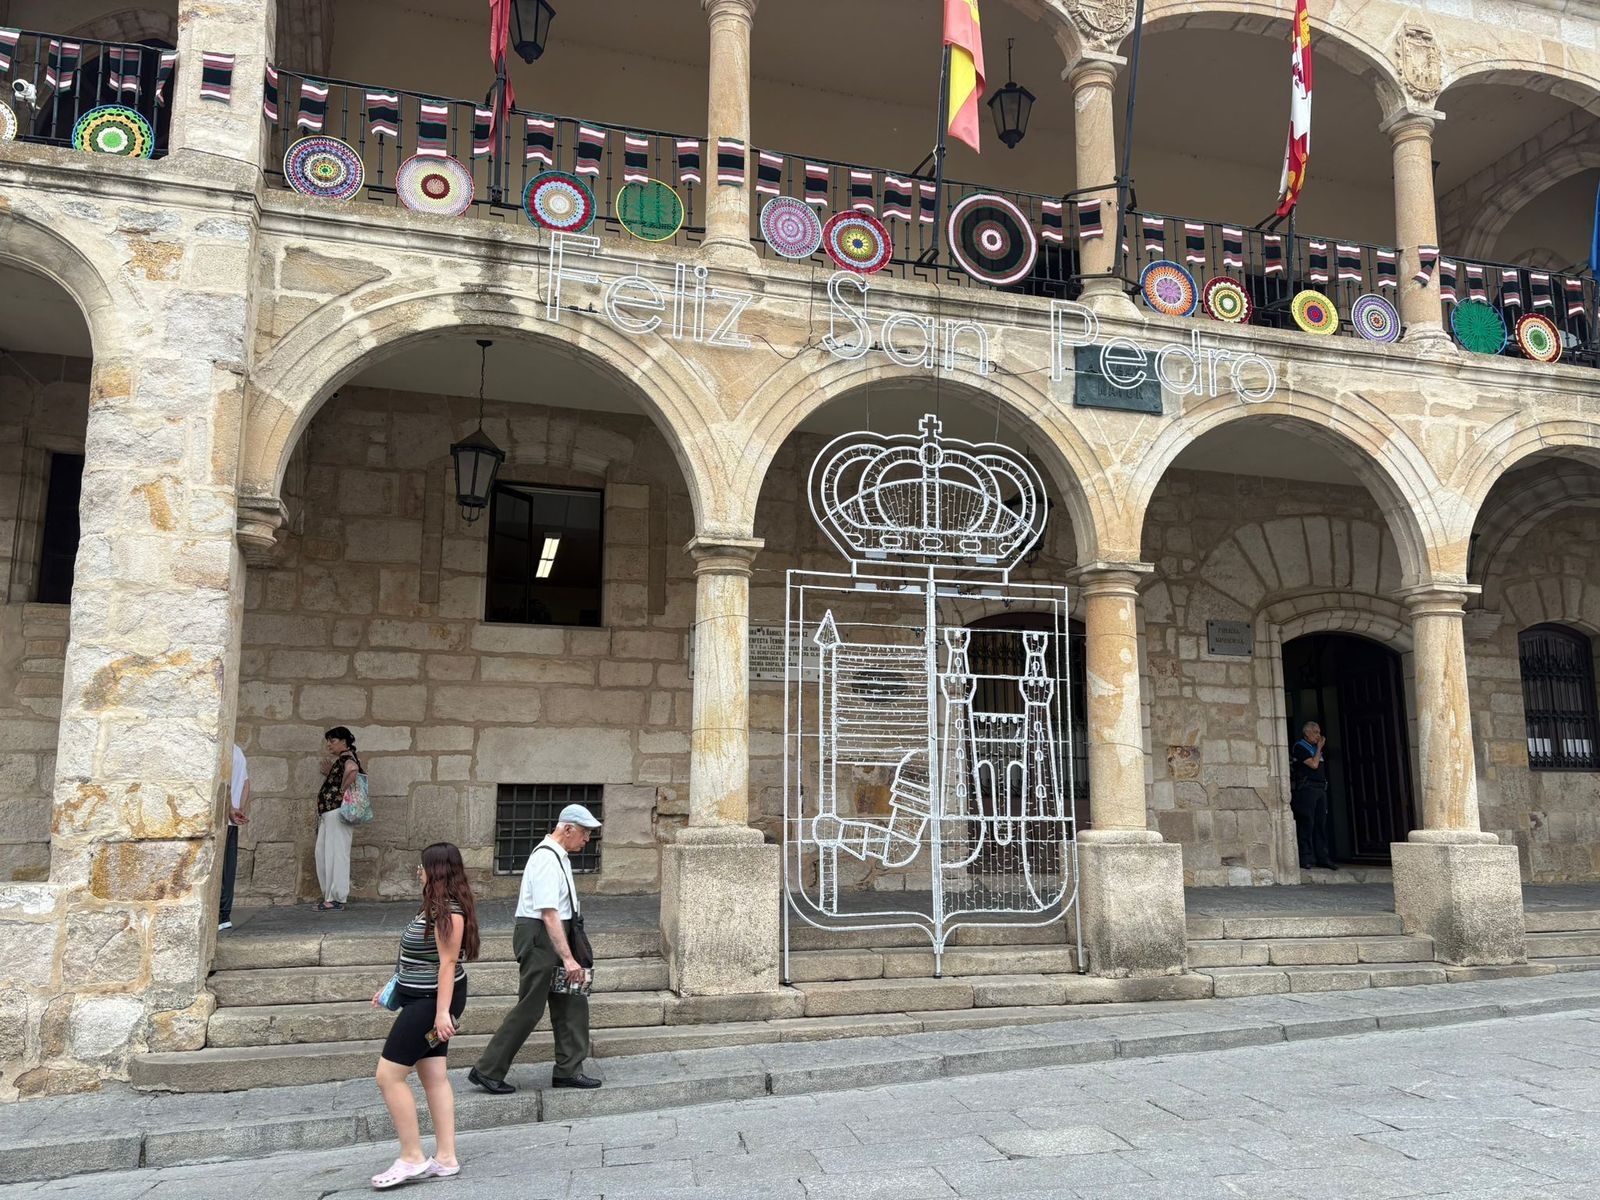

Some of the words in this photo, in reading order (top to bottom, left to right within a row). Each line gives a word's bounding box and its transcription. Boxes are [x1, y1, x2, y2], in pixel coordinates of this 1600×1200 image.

[546, 231, 754, 349] Feliz
[822, 270, 989, 375] San
[1050, 299, 1277, 403] Pedro
